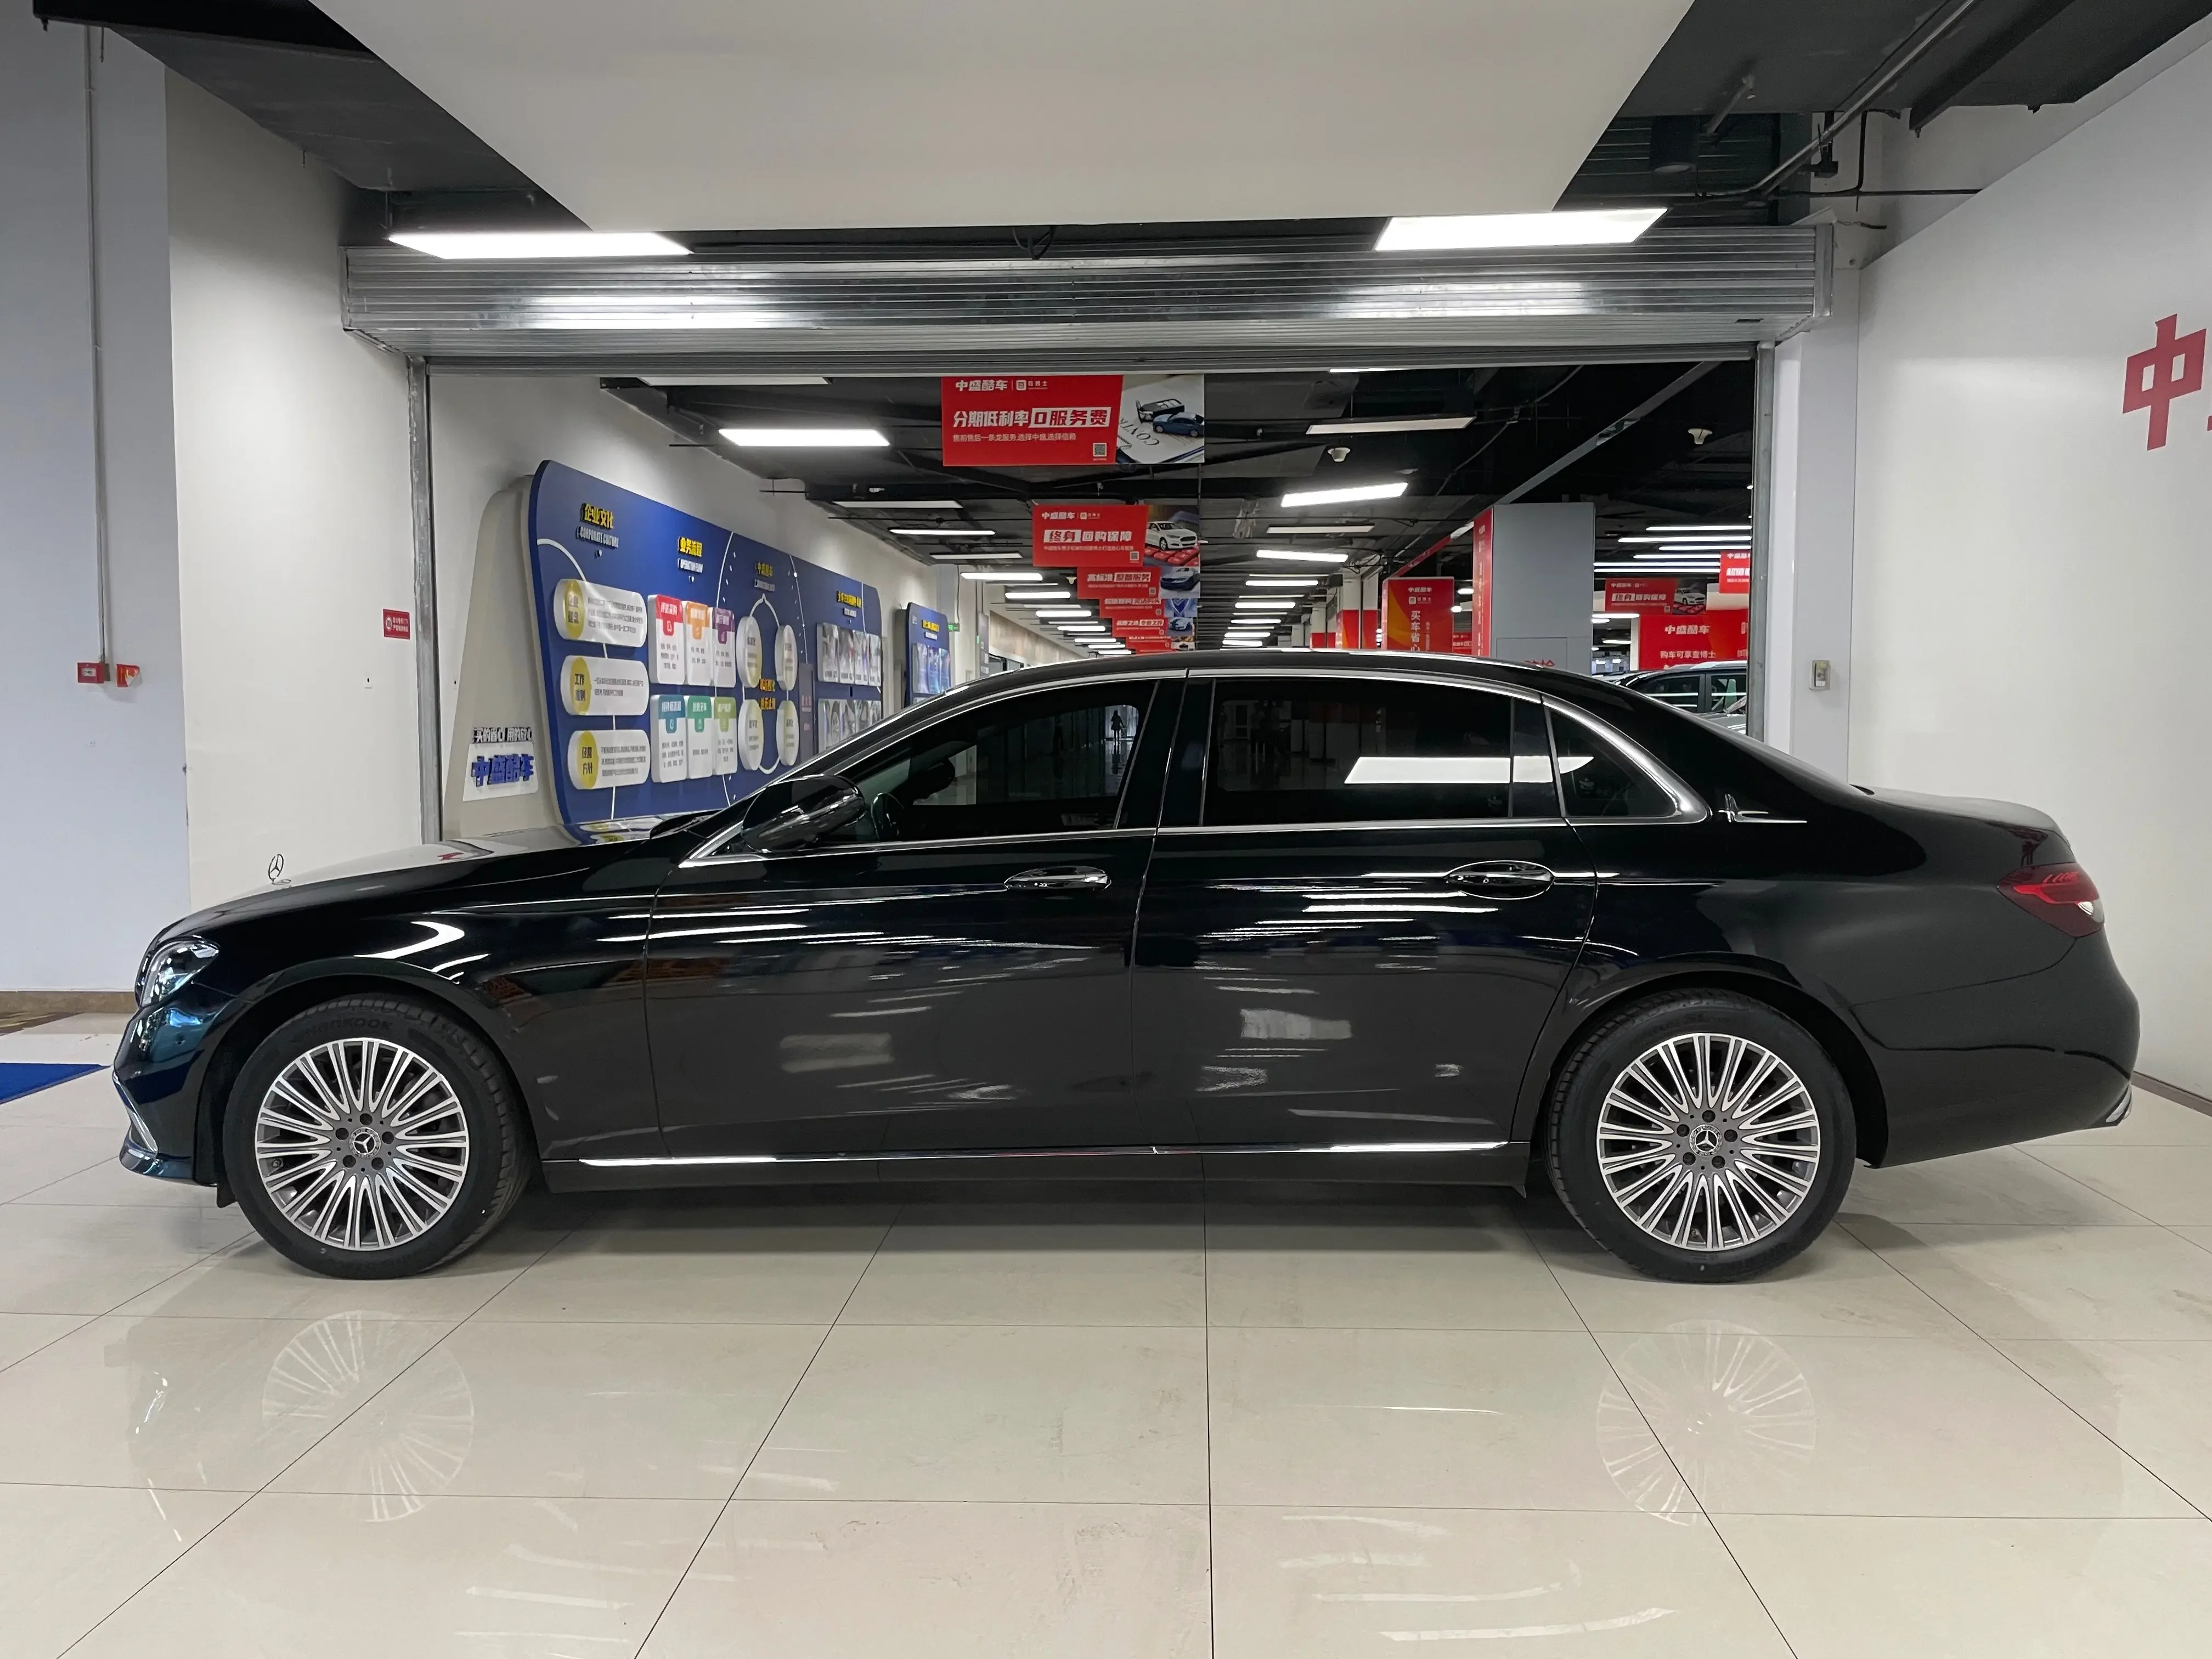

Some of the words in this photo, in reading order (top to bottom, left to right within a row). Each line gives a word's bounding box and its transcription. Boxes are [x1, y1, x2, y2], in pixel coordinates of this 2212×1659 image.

[956, 380, 1008, 391] 中盛酷车
[2122, 313, 2207, 451] 中
[1664, 625, 1709, 634] 中盛酷车
